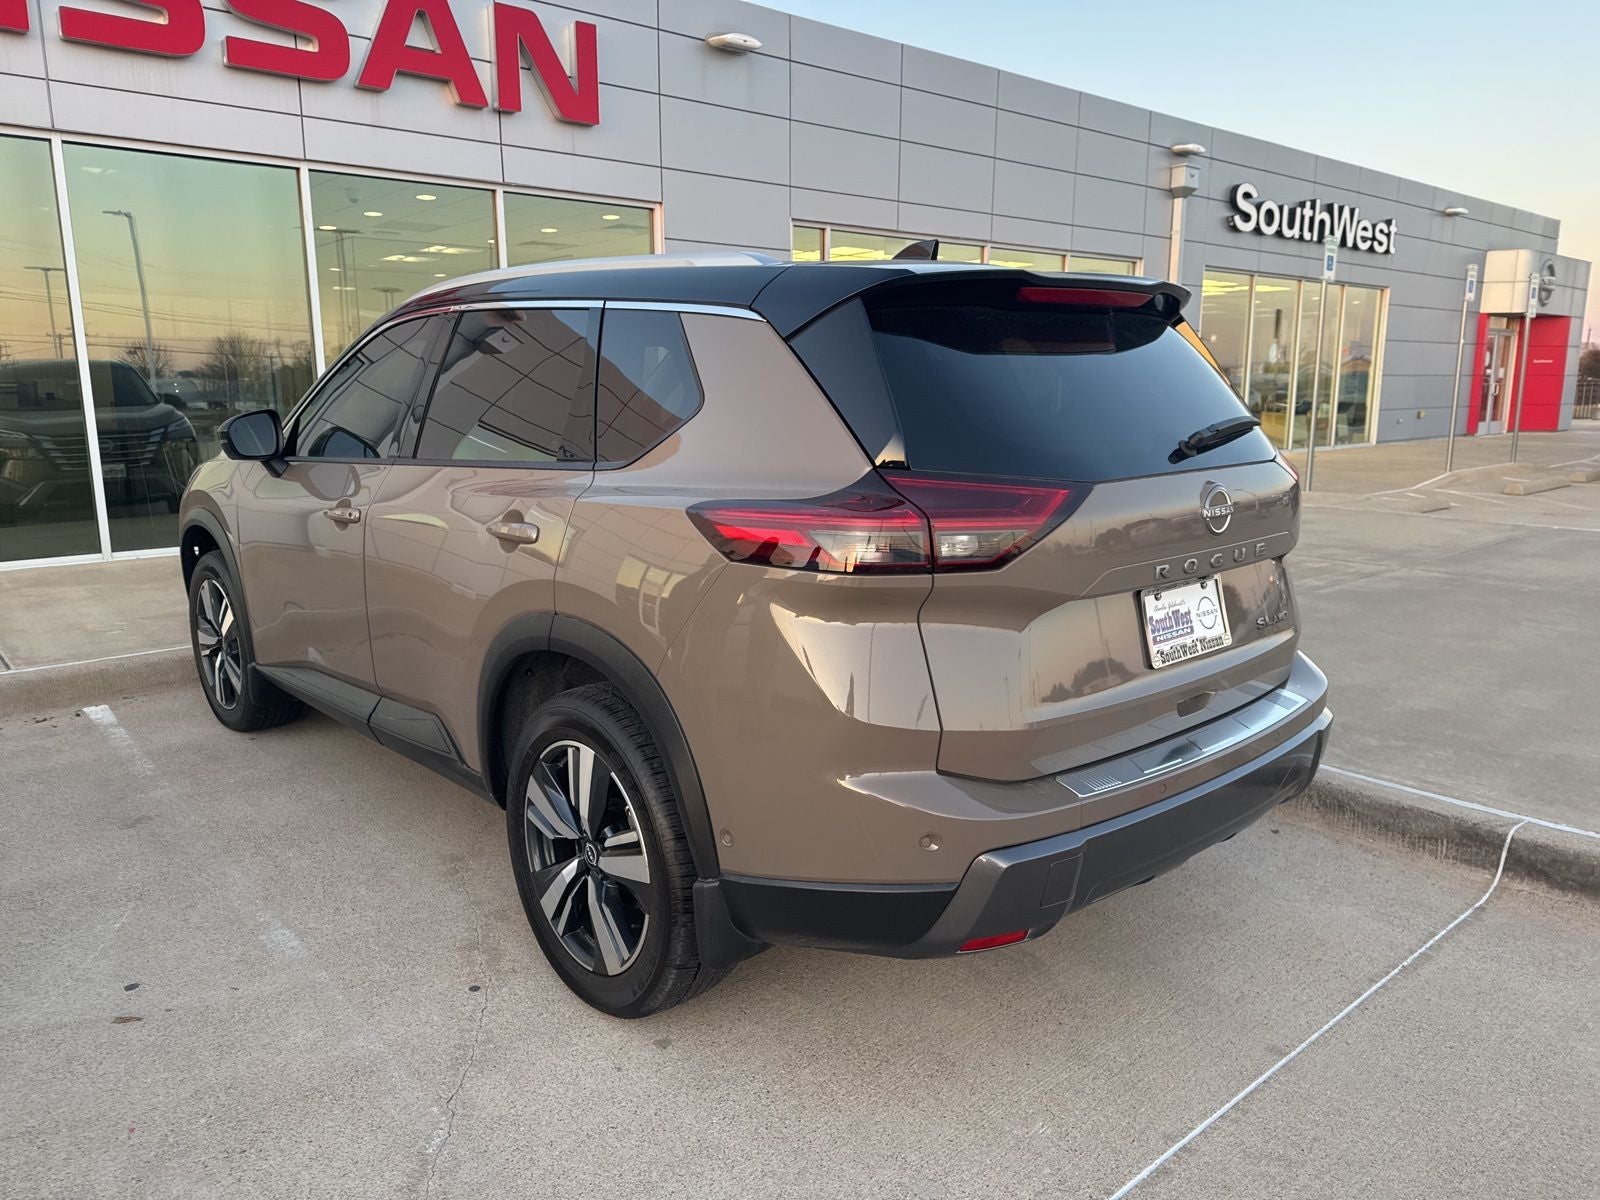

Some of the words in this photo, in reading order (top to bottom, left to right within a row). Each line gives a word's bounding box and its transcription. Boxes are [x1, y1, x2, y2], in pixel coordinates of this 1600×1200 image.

[0, 0, 600, 126] SAN
[1231, 182, 1398, 255] SouthWest
[1155, 542, 1266, 580] ROGUE
[1149, 607, 1193, 635] SouthWest
[1196, 608, 1218, 618] NISSAN
[1156, 627, 1191, 642] NISSAN
[1160, 641, 1199, 664] SouthWest
[1200, 636, 1224, 652] Nissan
